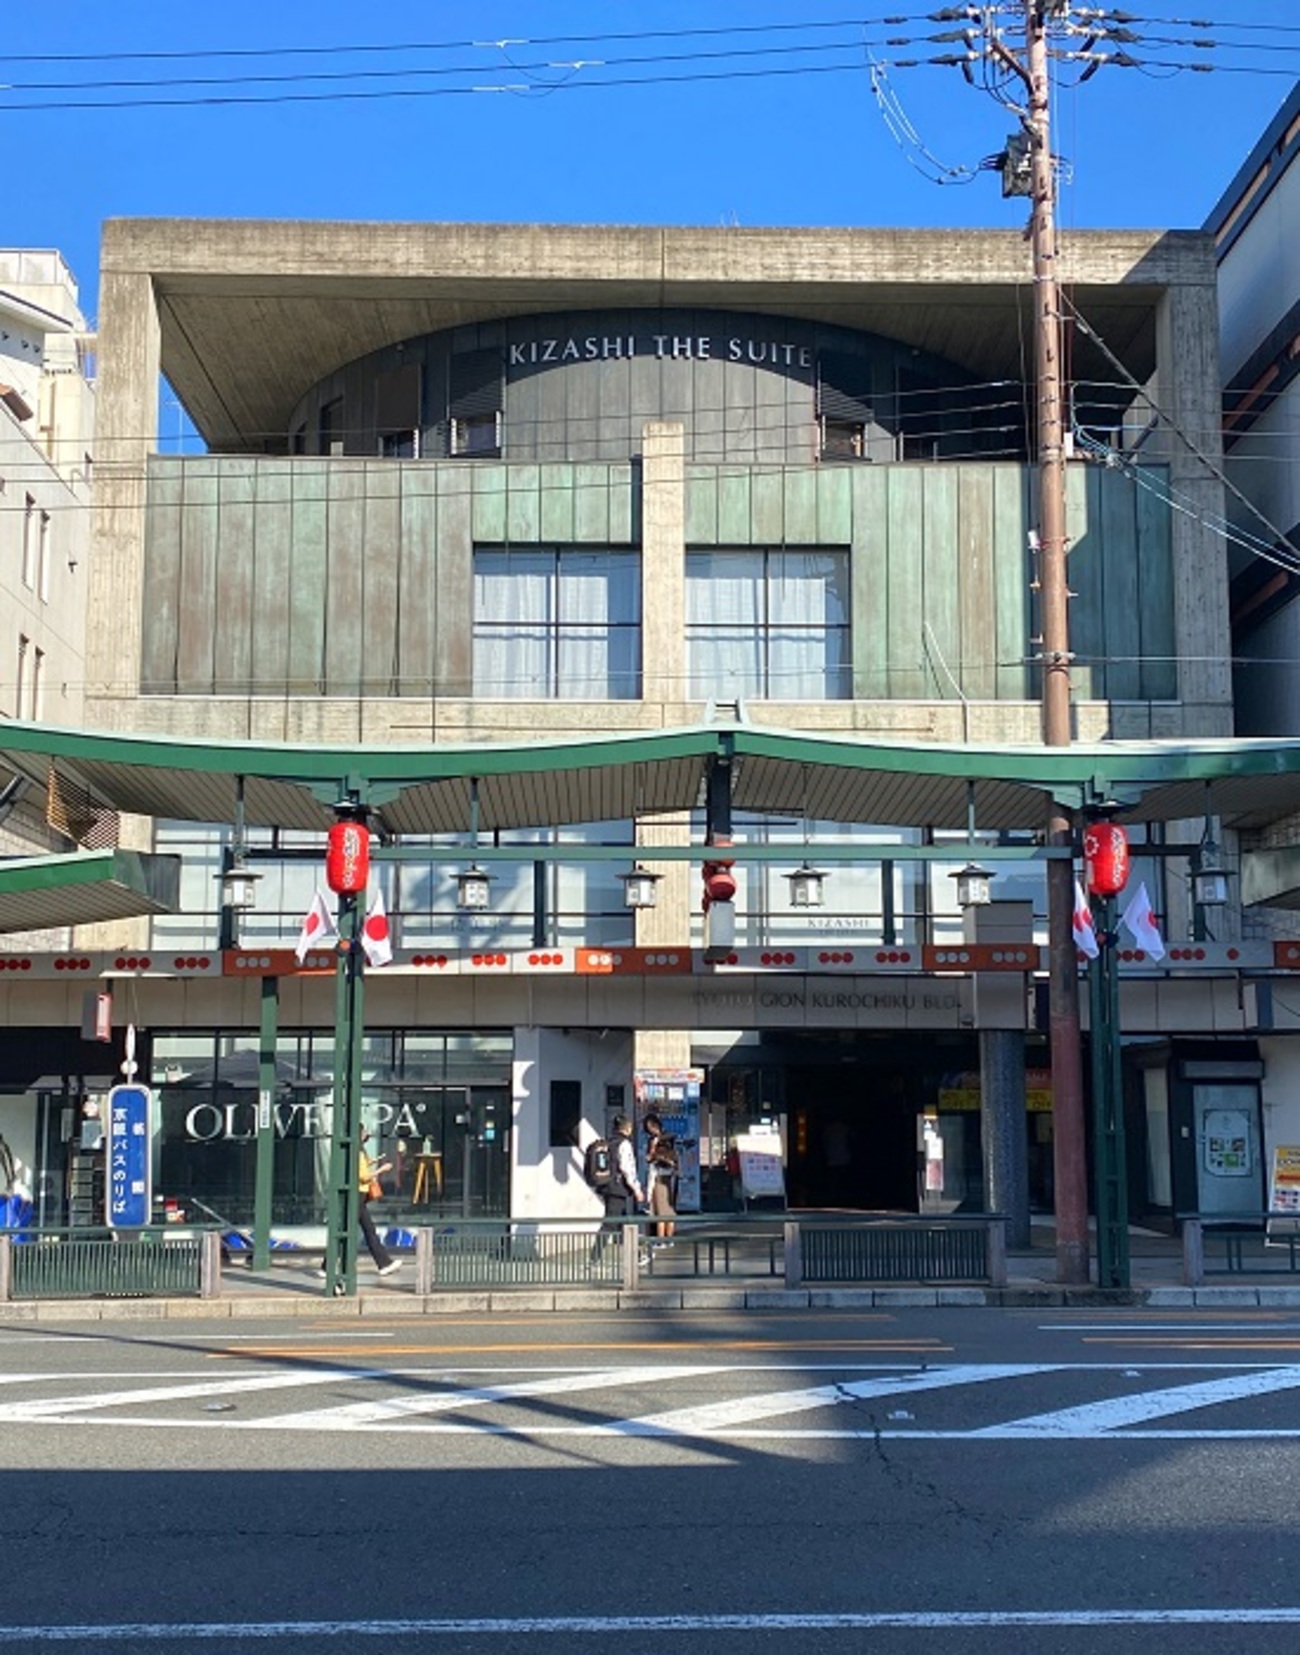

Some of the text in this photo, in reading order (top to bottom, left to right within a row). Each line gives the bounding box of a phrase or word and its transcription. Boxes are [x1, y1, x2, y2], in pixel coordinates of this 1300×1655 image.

[510, 335, 812, 367] KIZASHI THE SUITE
[760, 992, 805, 1008] GION
[813, 993, 915, 1009] KUROCHIKU
